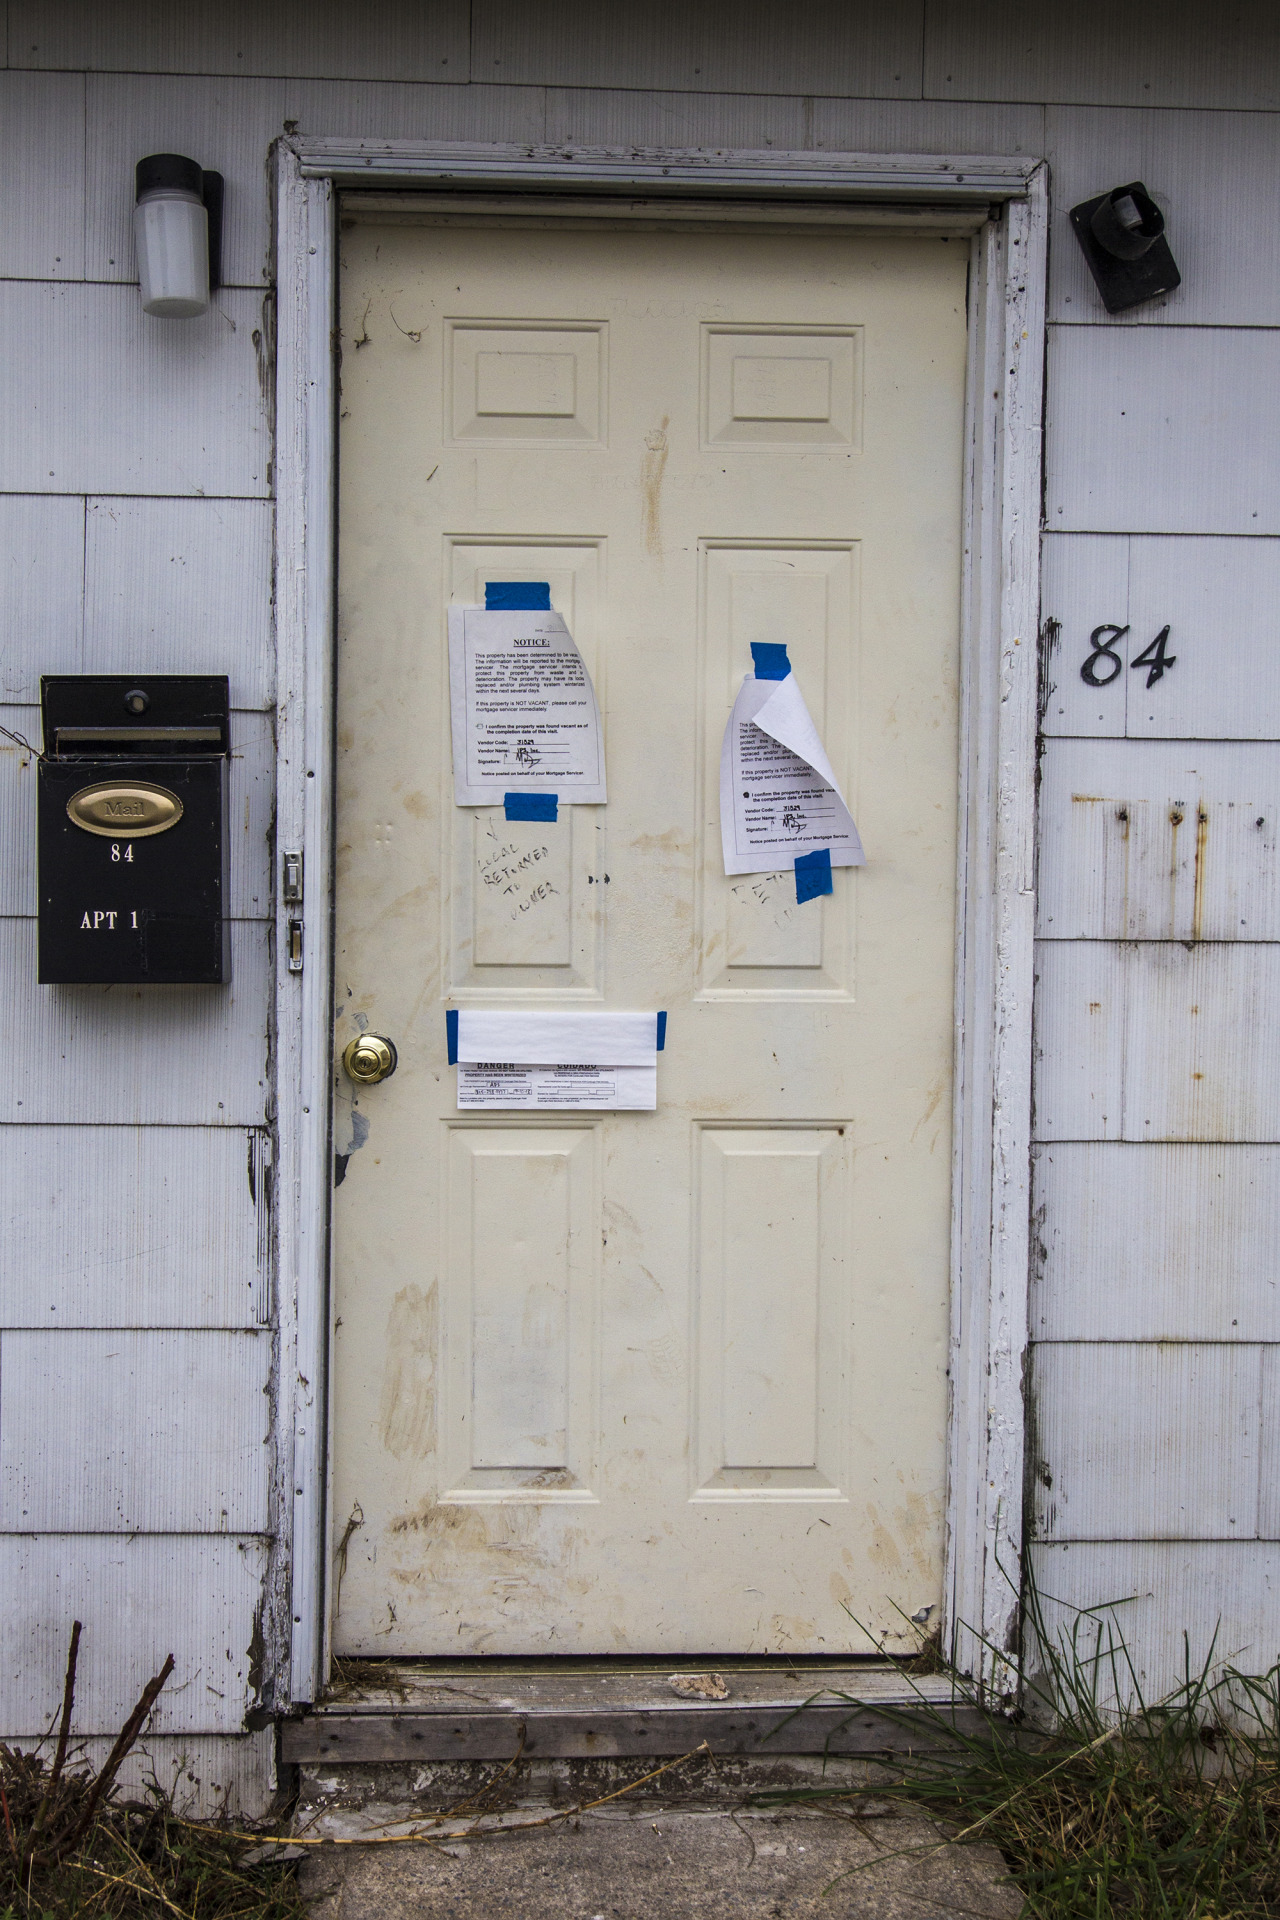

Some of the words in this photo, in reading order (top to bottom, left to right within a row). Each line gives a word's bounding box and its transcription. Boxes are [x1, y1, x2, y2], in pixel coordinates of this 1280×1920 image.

[513, 638, 550, 647] NOTICE:
[1080, 624, 1177, 689] 84
[104, 801, 145, 817] Mail
[111, 844, 134, 862] 84
[80, 911, 118, 929] APT
[130, 911, 138, 929] 1
